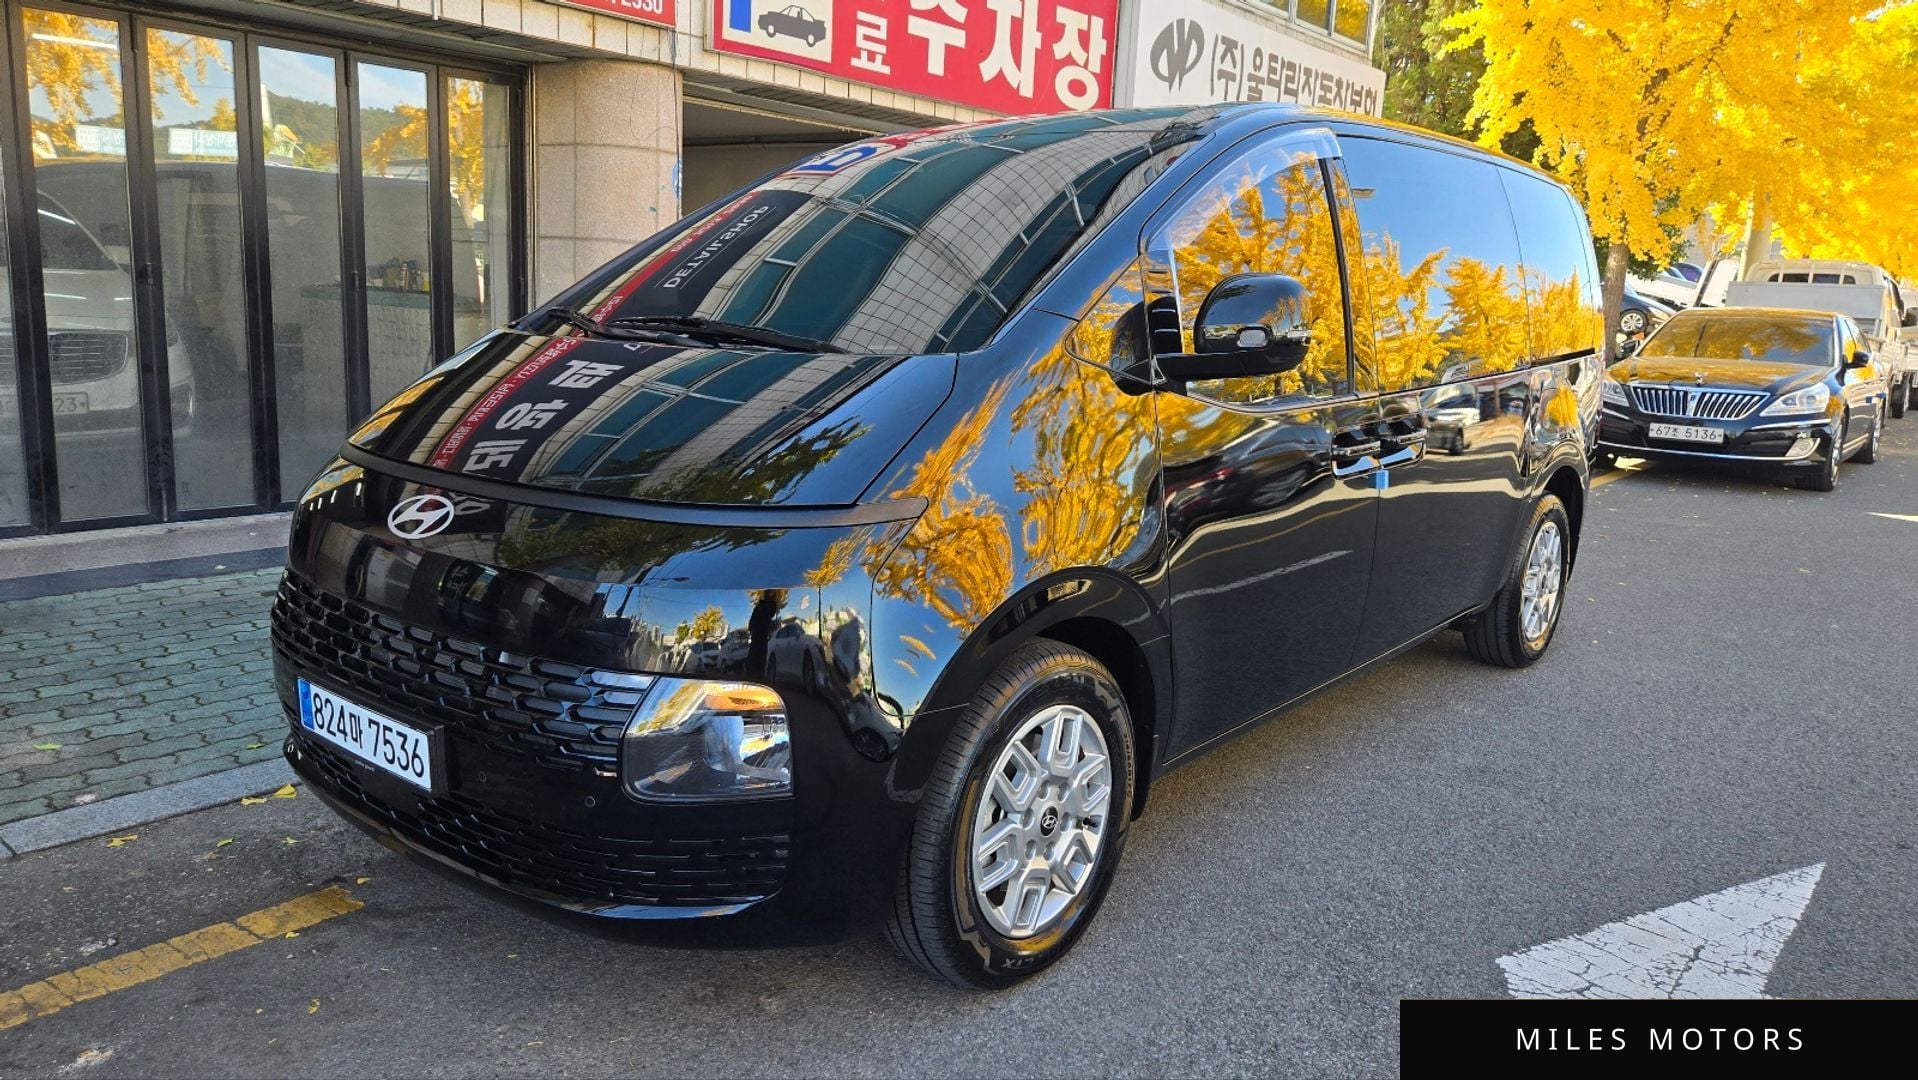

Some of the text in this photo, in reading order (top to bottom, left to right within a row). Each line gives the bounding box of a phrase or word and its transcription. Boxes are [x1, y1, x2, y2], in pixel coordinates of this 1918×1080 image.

[851, 9, 890, 75] 료
[1685, 428, 1717, 440] 5136
[313, 692, 425, 778] 824마 7536
